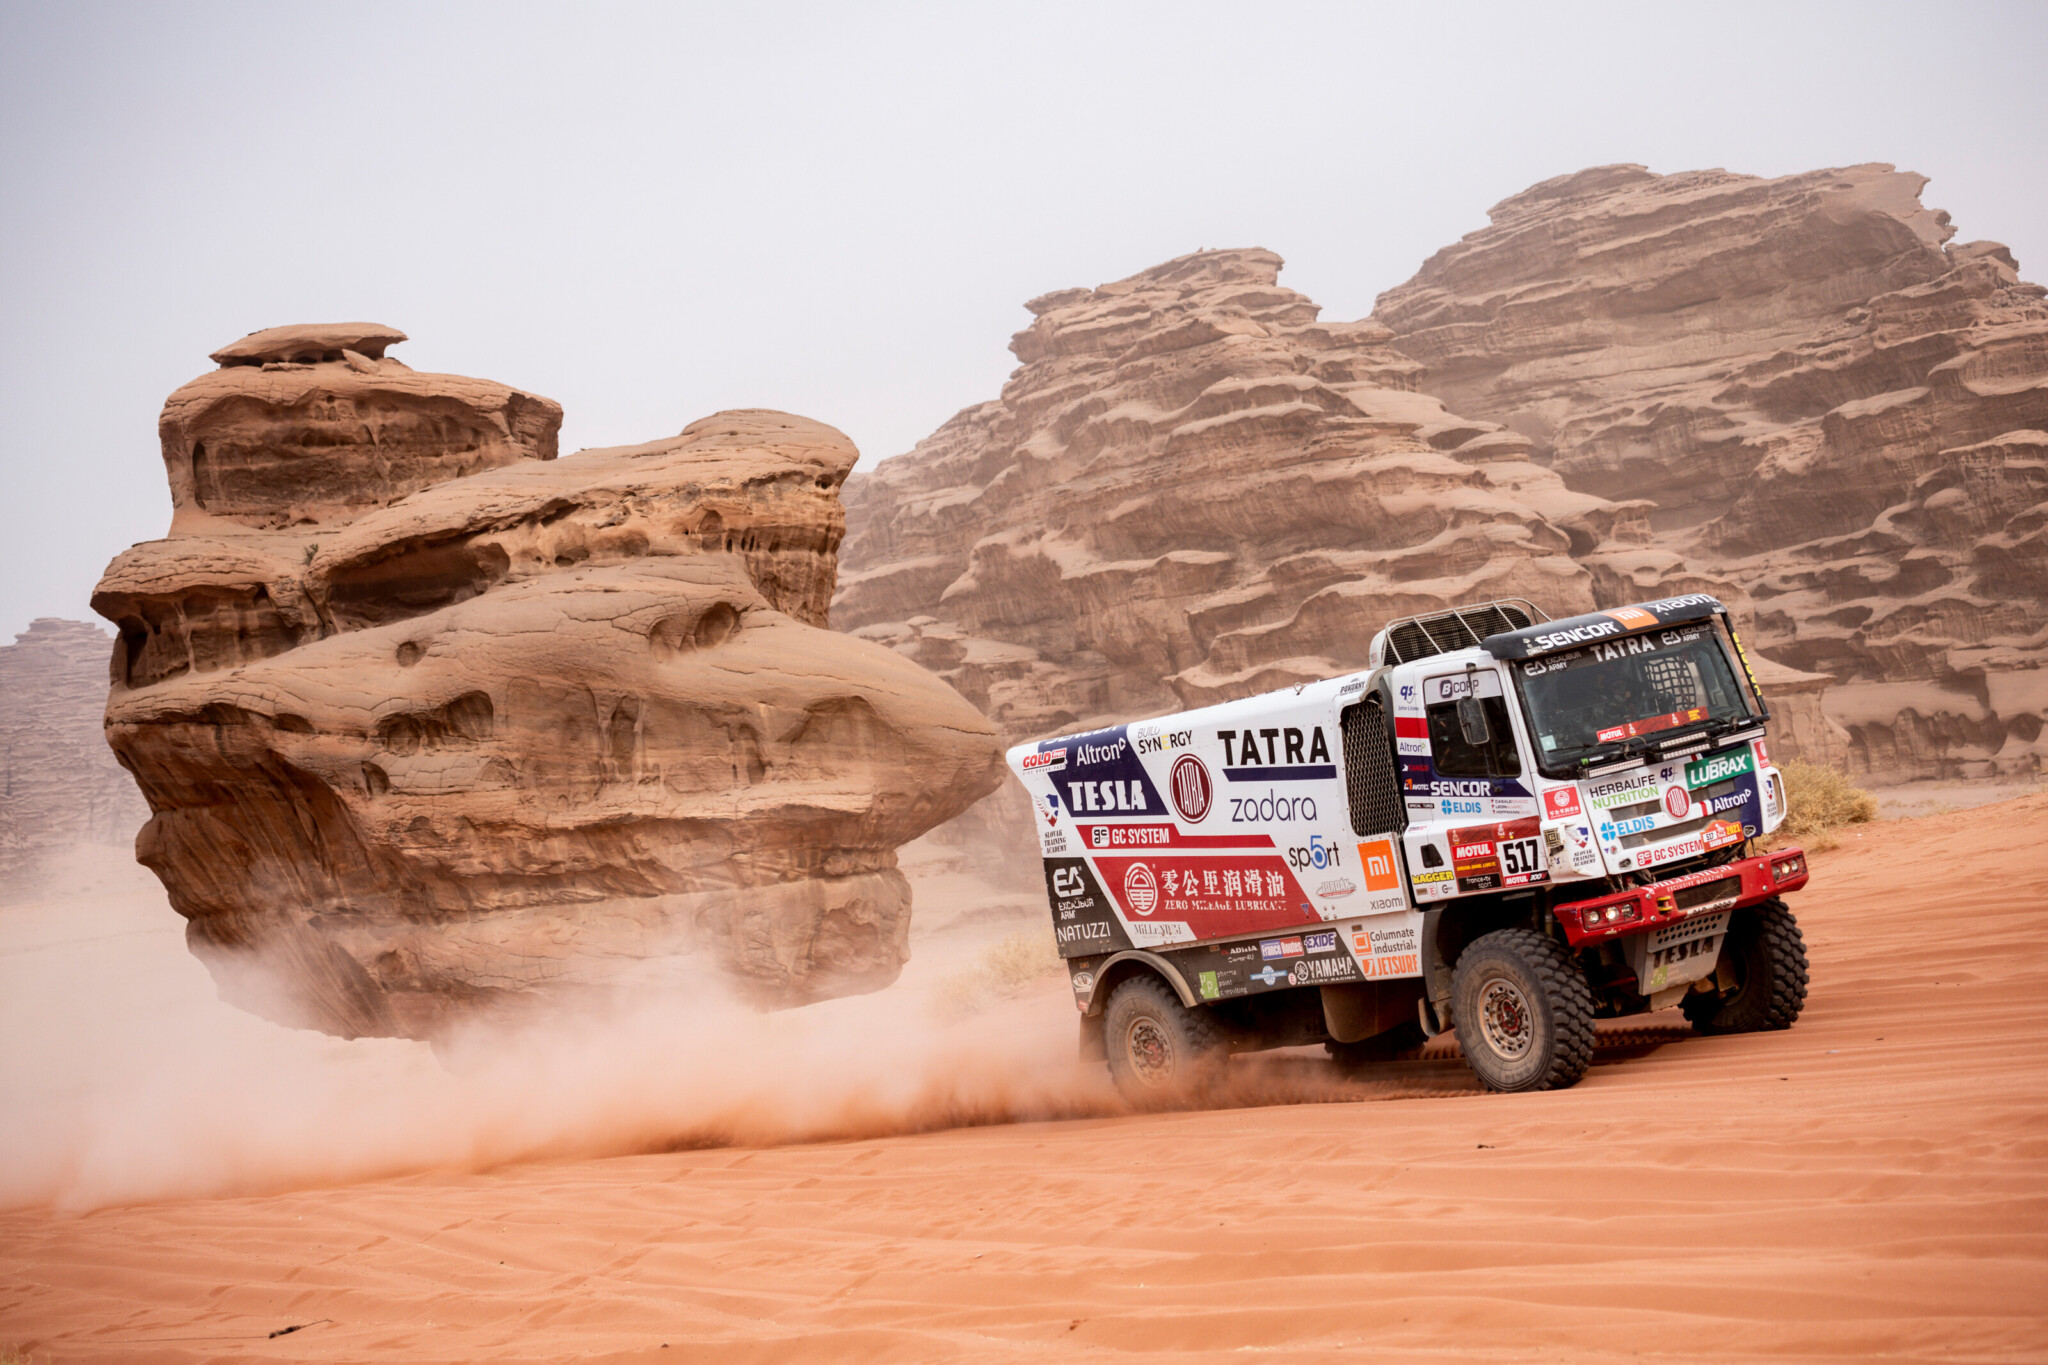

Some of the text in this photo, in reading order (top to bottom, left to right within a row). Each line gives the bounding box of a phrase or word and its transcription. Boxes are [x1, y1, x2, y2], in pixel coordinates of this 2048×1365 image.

[1535, 622, 1620, 649] SENCOR
[1680, 624, 1711, 636] EXCALIBUR
[1683, 633, 1700, 642] ARMY
[1590, 635, 1655, 662] TATRA
[1545, 652, 1582, 666] EXCALIBUR
[1548, 662, 1567, 671] ARMY
[1139, 730, 1192, 754] SYNERGY
[1600, 729, 1623, 741] MOTUL
[1217, 726, 1331, 766] TATRA
[1023, 751, 1051, 768] GOLD
[1077, 744, 1120, 766] Altron
[1690, 754, 1748, 785] LUBRAX
[1431, 781, 1491, 796] SENCOR
[1589, 775, 1656, 798] HERBALIFE
[1068, 780, 1147, 811] TESLA
[1592, 786, 1659, 810] NUTRITION
[1714, 793, 1748, 812] Altron
[1230, 788, 1317, 822] zadara
[1453, 802, 1481, 813] ELDIS
[1616, 816, 1655, 835] ELDIS
[1726, 824, 1740, 835] 2021
[1044, 837, 1066, 845] TRAINING
[1112, 830, 1126, 844] GC
[1128, 828, 1170, 844] SYSTEM
[1046, 845, 1067, 853] ACADEMY
[1457, 844, 1491, 858] MOTUL
[1503, 839, 1539, 874] 517
[1654, 849, 1667, 861] GC
[1668, 839, 1703, 857] SYSTEM
[1573, 854, 1595, 863] TRAINING
[1574, 859, 1596, 867] ACADEMY
[1161, 868, 1286, 897] 零公里润滑油
[1506, 875, 1528, 885] MOTUL
[1667, 881, 1694, 892] EXCLUSIVE
[1165, 900, 1188, 910] ZERO
[1192, 900, 1232, 910] MILEAGE
[1370, 897, 1403, 910] xiaomi
[1057, 921, 1111, 943] NATUZZI
[1370, 928, 1415, 942] Columnate
[1305, 933, 1335, 948] EXIDE
[1262, 943, 1282, 957] France
[1281, 941, 1303, 954] Routes
[1653, 936, 1714, 968] TESLA
[1307, 957, 1356, 978] YAMAHA
[1377, 954, 1418, 976] JETSURF
